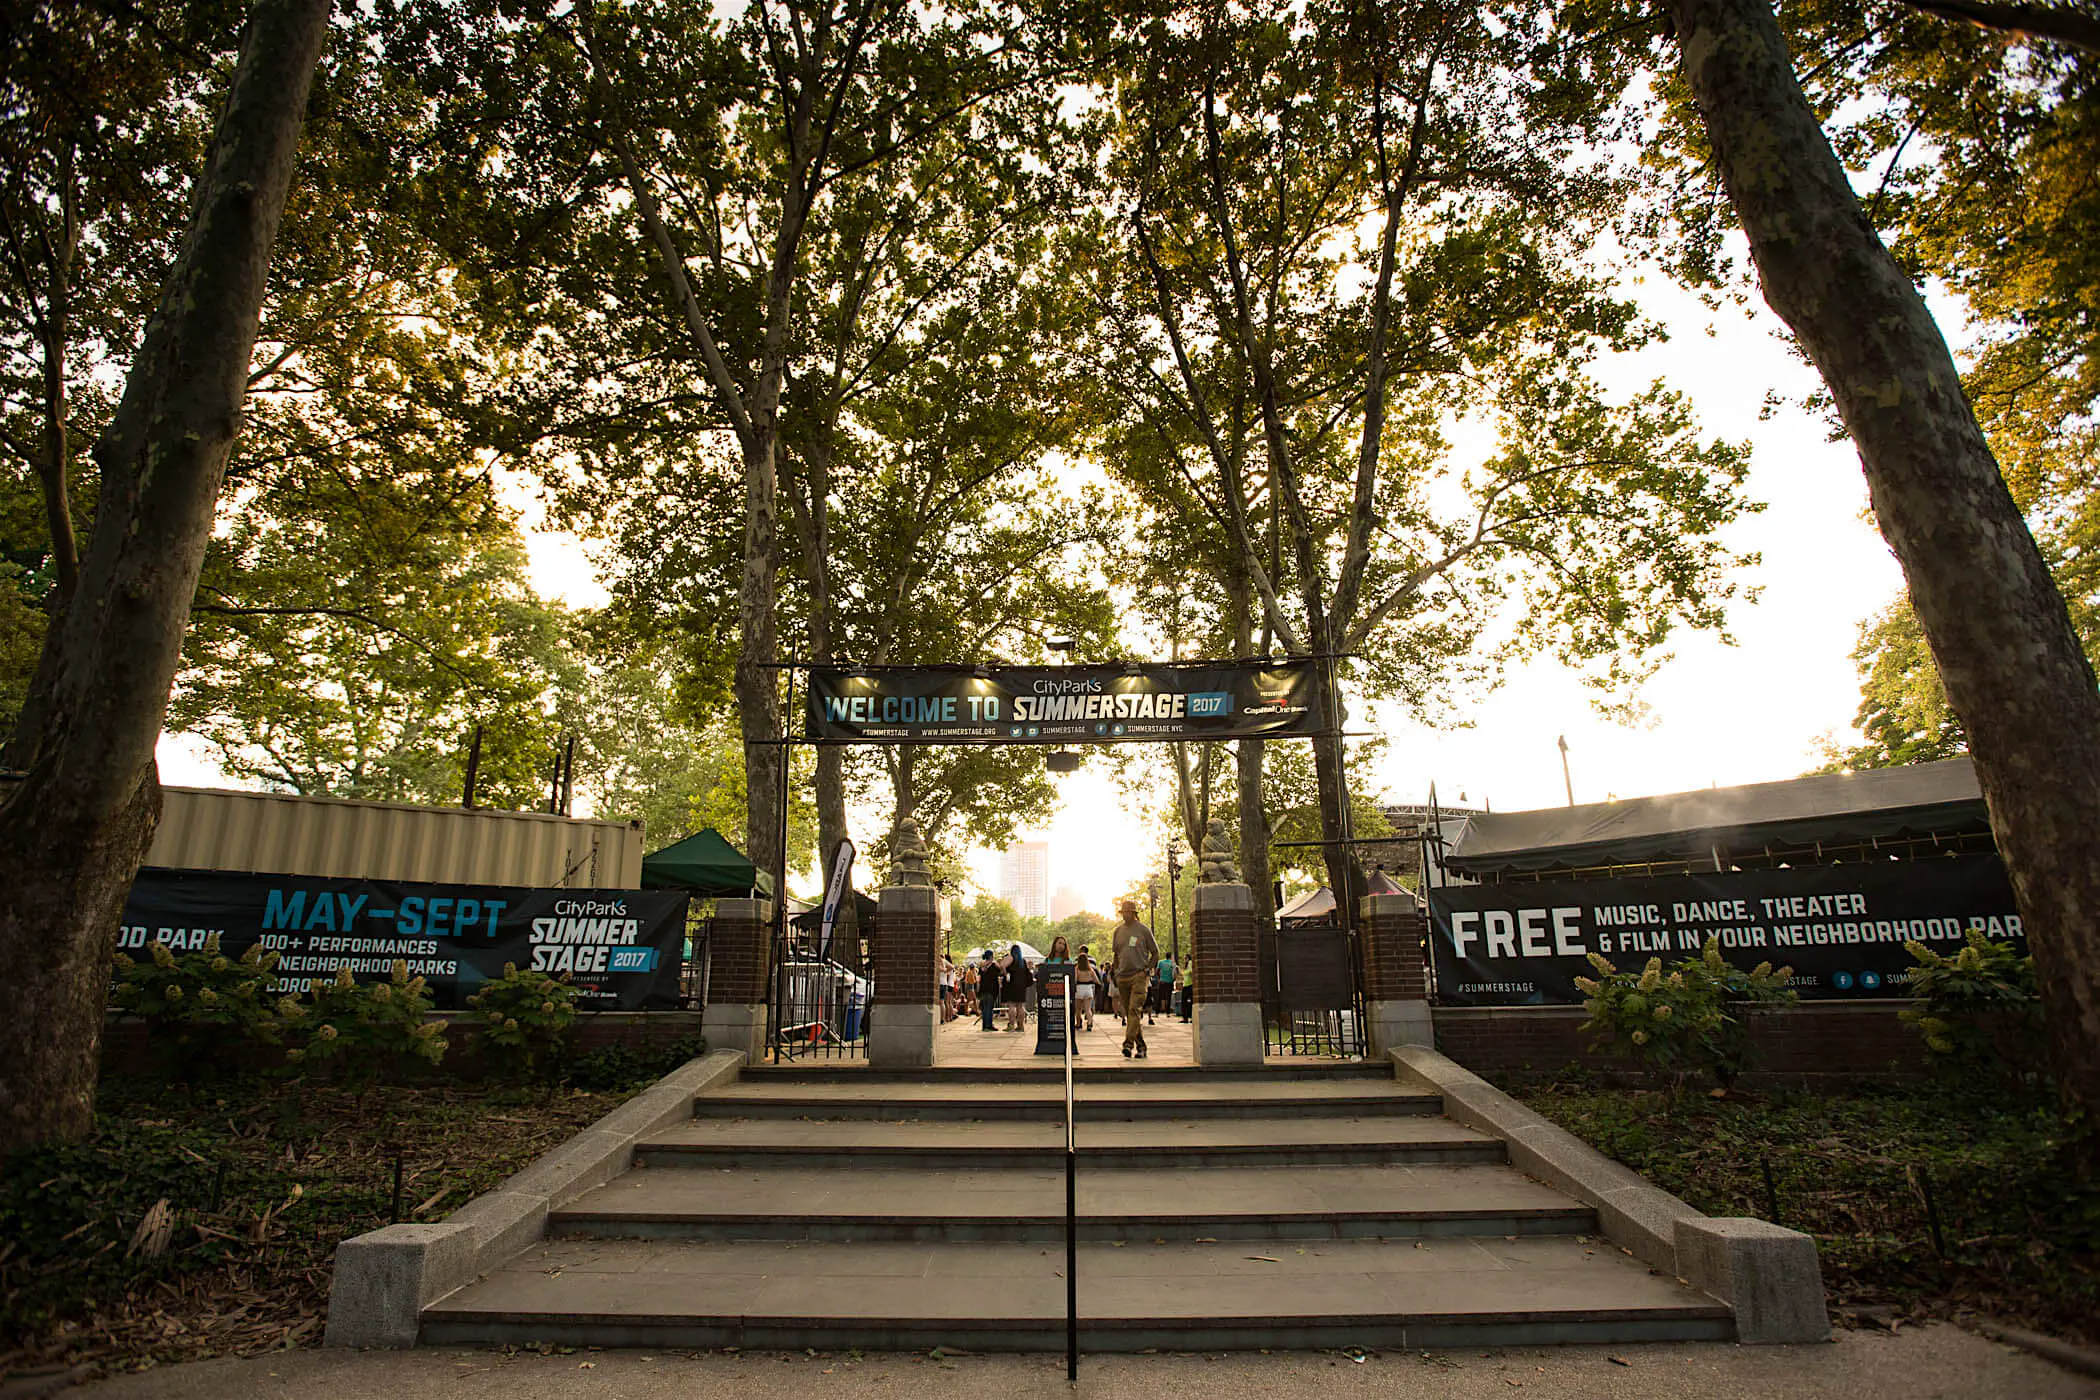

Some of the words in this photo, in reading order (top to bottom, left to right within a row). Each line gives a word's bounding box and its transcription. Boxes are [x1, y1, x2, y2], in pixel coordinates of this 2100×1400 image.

[1033, 679, 1102, 695] CityParks
[824, 696, 957, 723] WELCOME
[967, 696, 1000, 721] TO
[1012, 693, 1185, 721] SUMMERSTAGE
[1192, 697, 1222, 713] 2017
[921, 727, 996, 737] WWW.SUMMERSTAGE.ORG
[1042, 726, 1086, 734] SUMMERSTAGE
[1127, 725, 1170, 733] SUMMERSTAGE
[1171, 725, 1183, 733] NYC
[554, 899, 627, 917] CityParks
[1593, 904, 1667, 926] MUSIC,
[1672, 899, 1756, 923] DANCE,
[1760, 893, 1868, 919] THEATER
[529, 918, 638, 945] SUMMER
[1450, 906, 1587, 959] FREE
[1599, 932, 1612, 952] &
[1620, 931, 1671, 952] FILM
[1677, 929, 1701, 950] IN
[1704, 925, 1768, 948] YOUR
[1774, 917, 1961, 947] NEIGHBORHOOD
[258, 934, 304, 950] 100+
[308, 936, 440, 955] PERFORMANCES
[277, 955, 397, 974] NEIGHBORHOO
[407, 959, 457, 975] PARKS
[530, 945, 610, 973] STAGE
[613, 952, 646, 967] 2017
[1458, 982, 1534, 993] #SUMMERSTAGE
